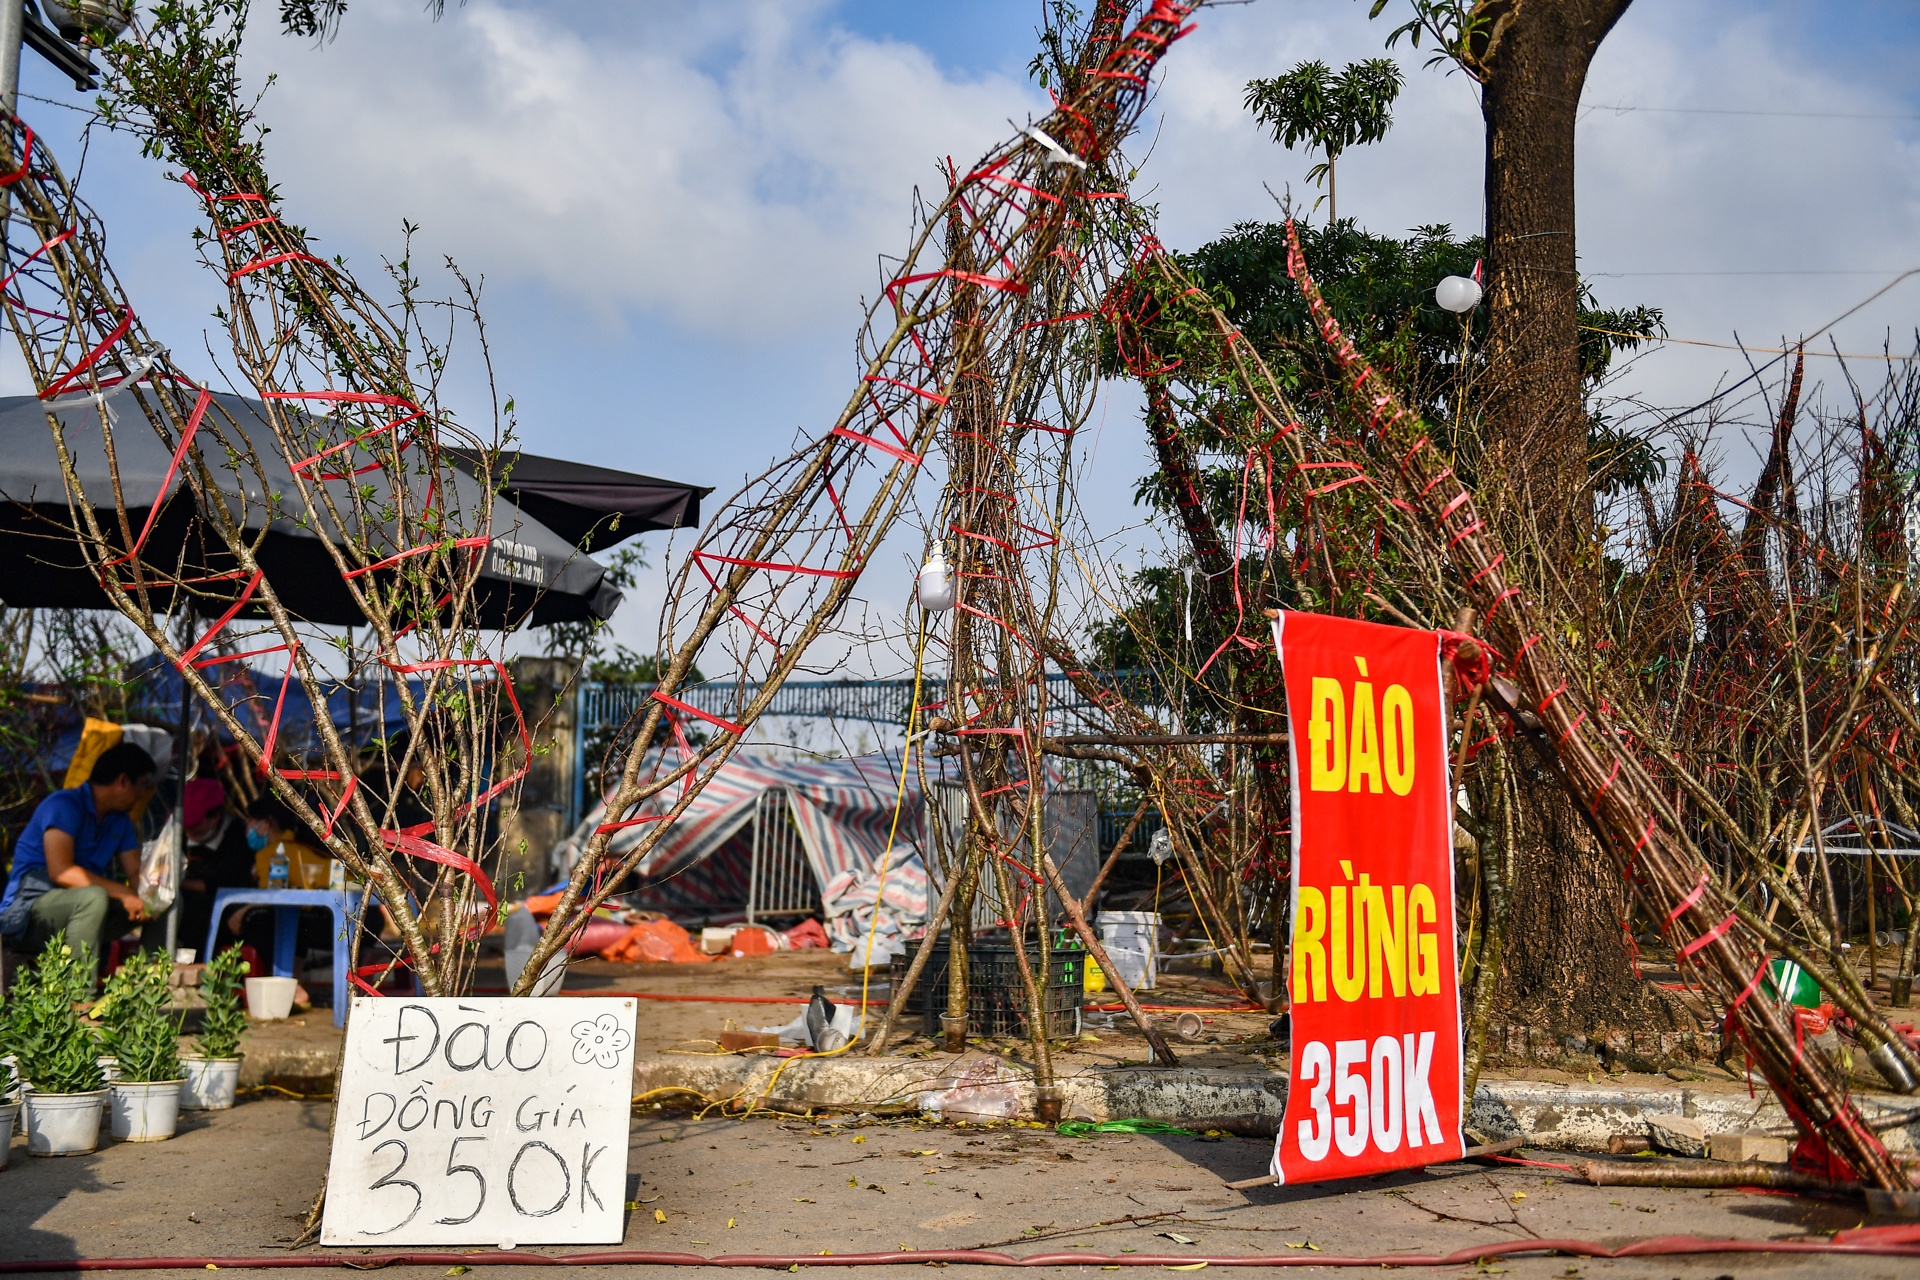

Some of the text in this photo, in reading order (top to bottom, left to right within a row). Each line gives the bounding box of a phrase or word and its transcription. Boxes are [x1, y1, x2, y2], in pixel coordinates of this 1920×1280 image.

[1308, 656, 1415, 796] ĐÀO
[1293, 860, 1440, 1004] RỪNG
[383, 1004, 548, 1076] Đào
[1298, 1031, 1445, 1162] 350K
[356, 1079, 495, 1141] ĐỒNG
[357, 1134, 608, 1236] 350K
